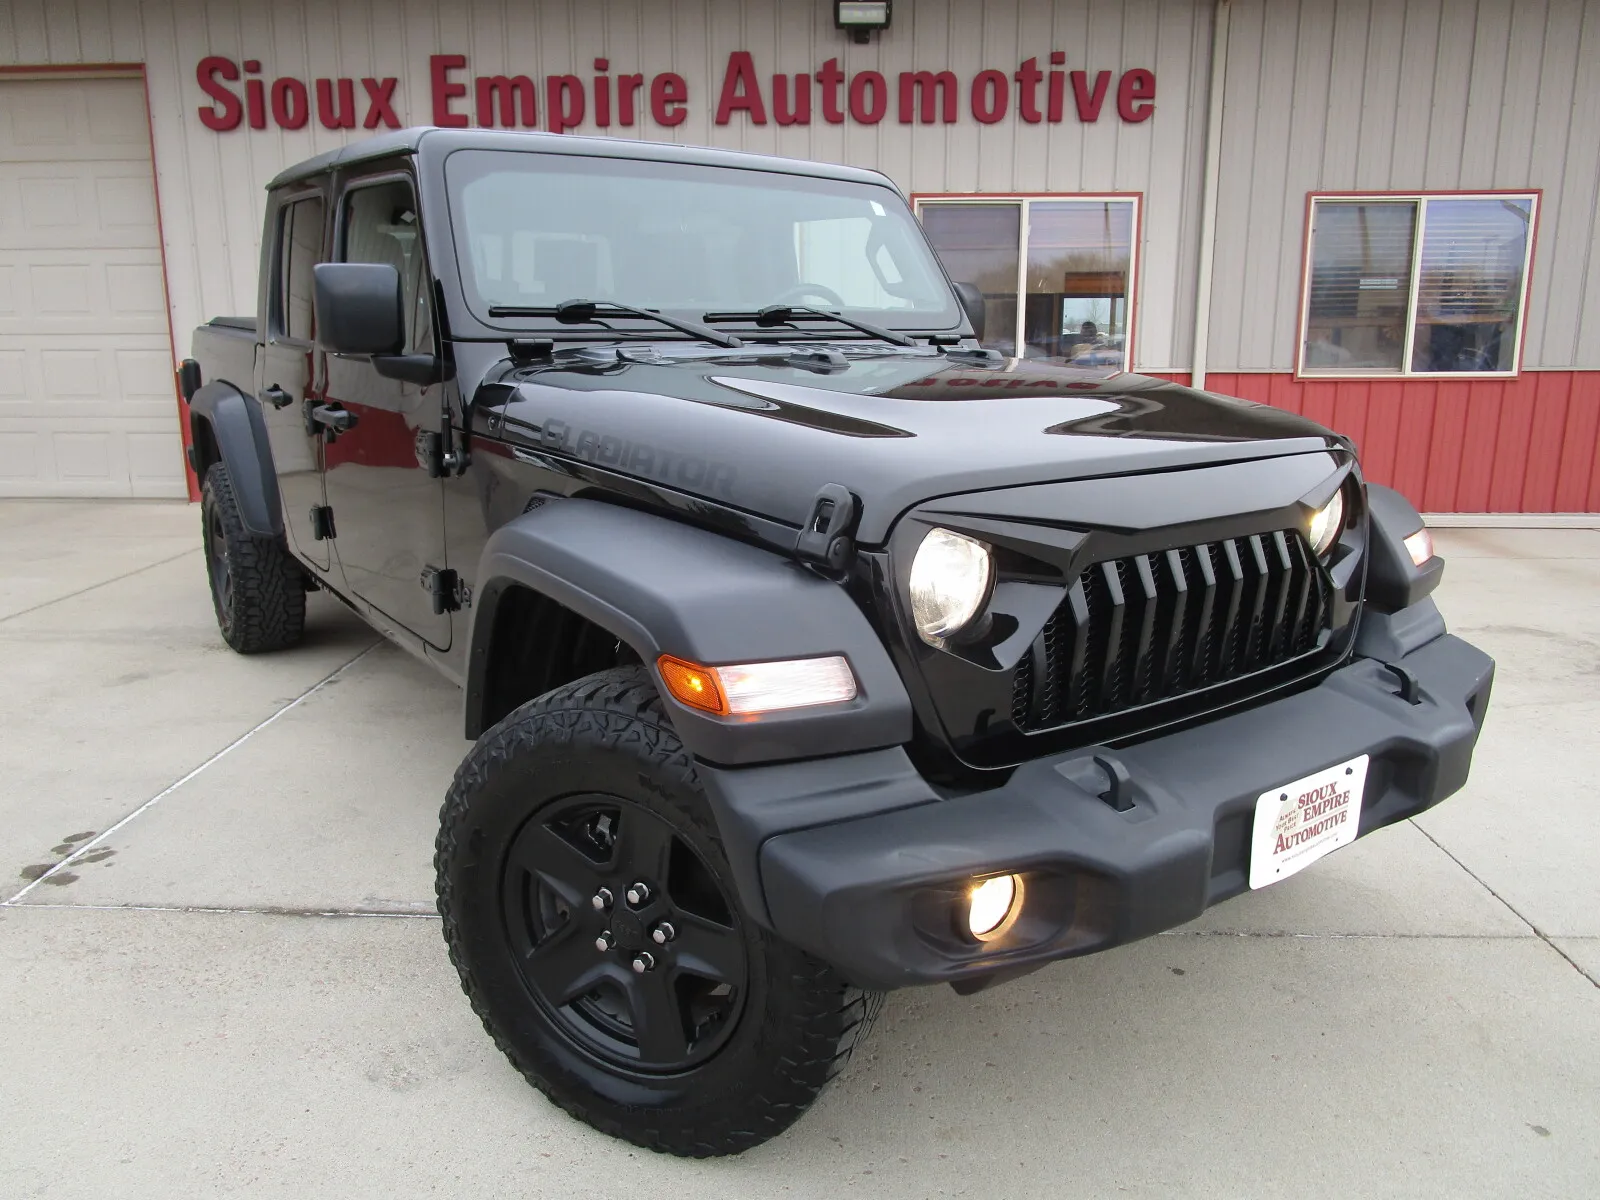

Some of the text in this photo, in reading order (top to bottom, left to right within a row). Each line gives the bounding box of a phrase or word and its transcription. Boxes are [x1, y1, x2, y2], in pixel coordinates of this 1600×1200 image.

[196, 51, 1156, 134] Sioux Empire Automotive
[540, 417, 738, 499] GLADIATOR
[1297, 781, 1338, 810] SIOUX
[1303, 790, 1350, 823] EMPIRE
[1273, 810, 1348, 855] AUTOMOTIVE
